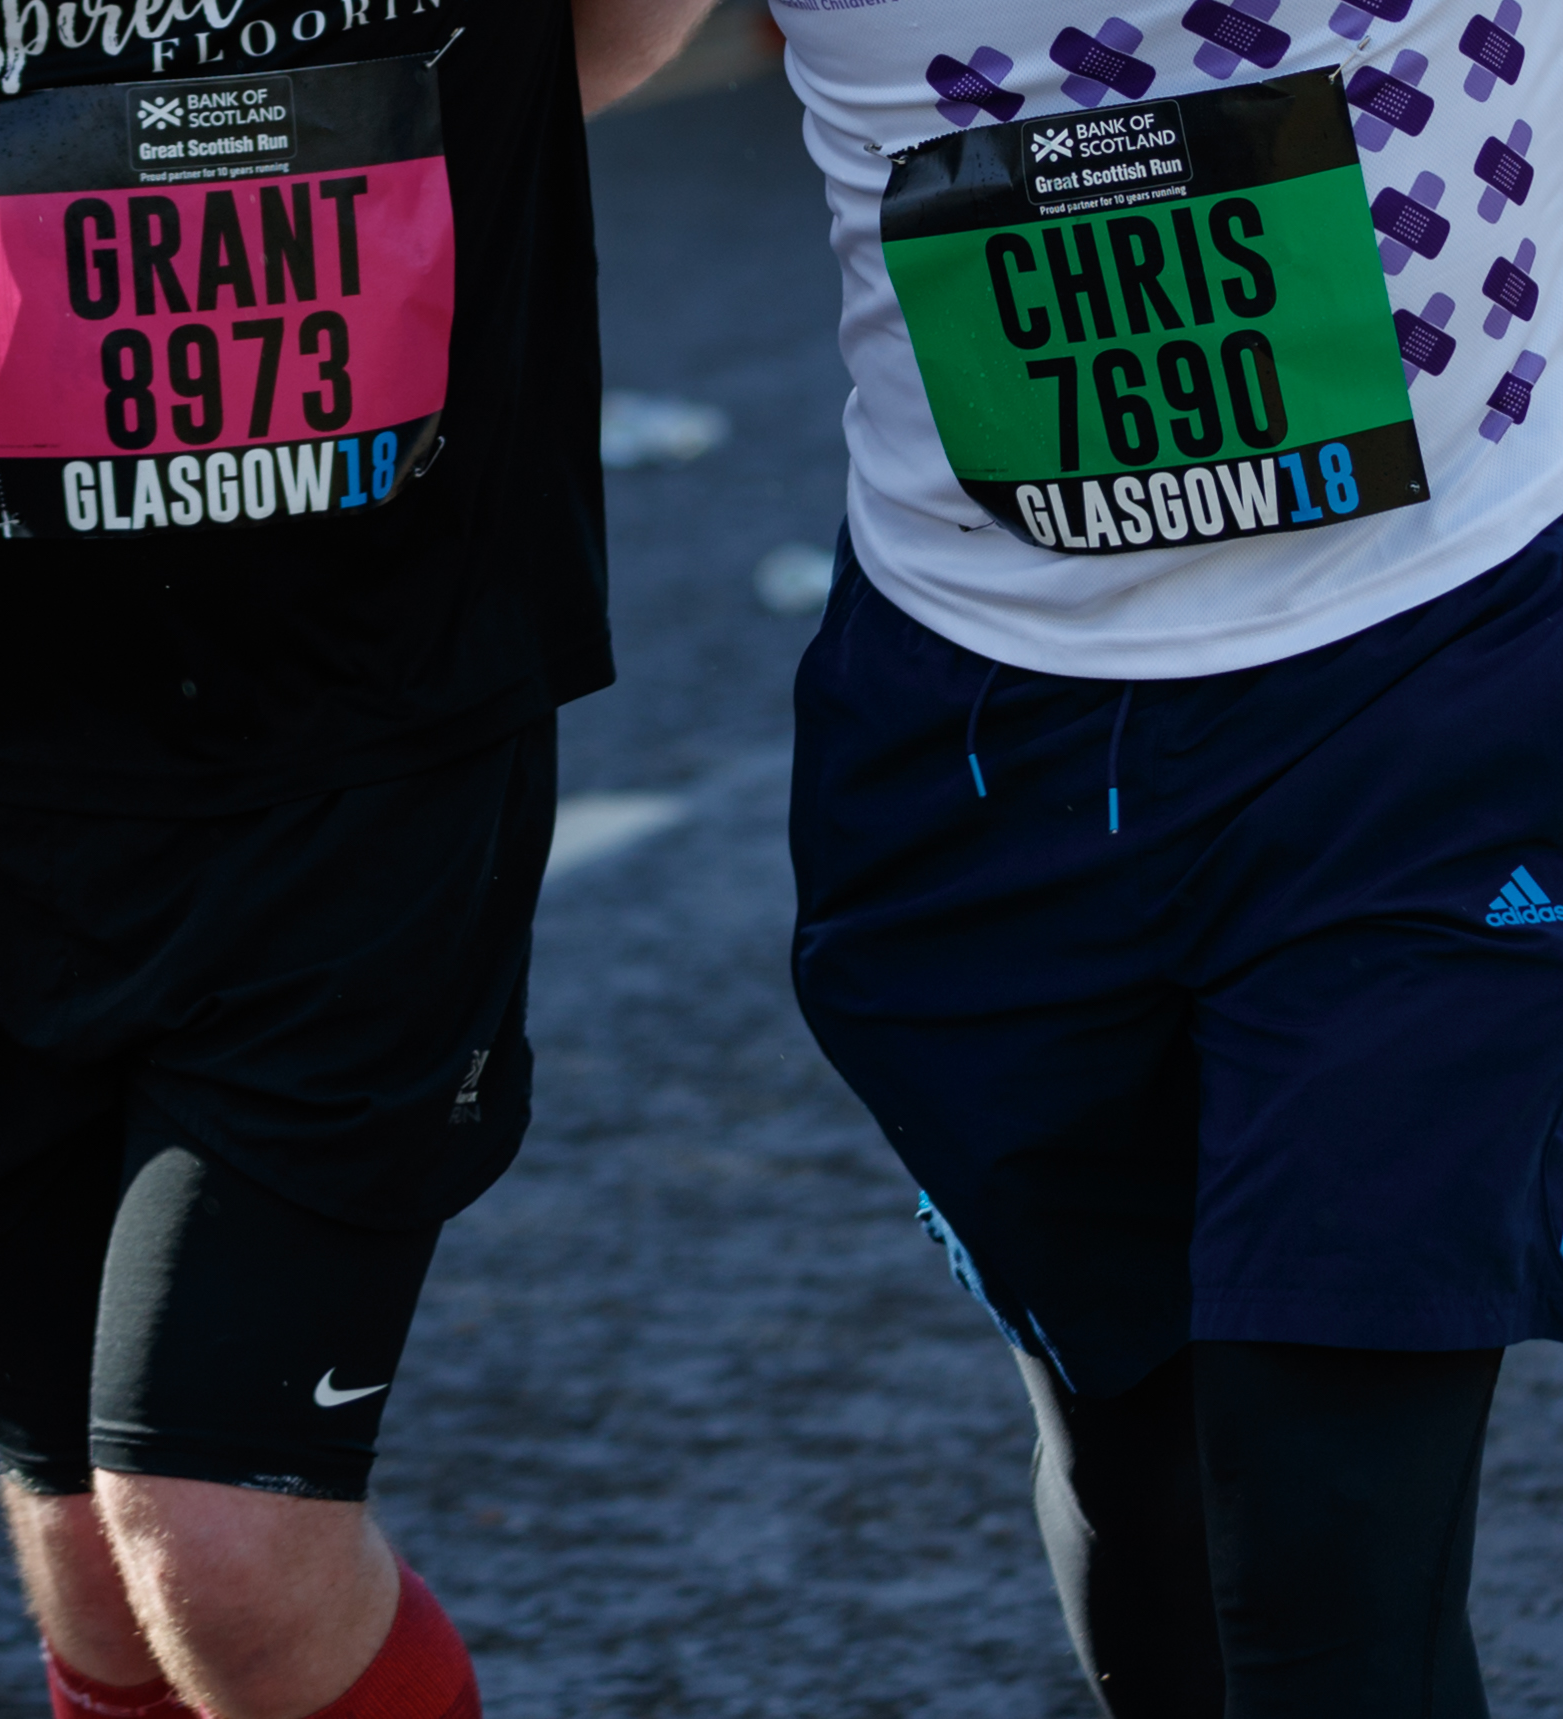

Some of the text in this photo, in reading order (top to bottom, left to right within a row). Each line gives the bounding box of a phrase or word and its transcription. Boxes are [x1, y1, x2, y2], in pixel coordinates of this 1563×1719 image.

[187, 88, 268, 110] BANK OF
[188, 105, 286, 128] SCOTLAND
[1076, 113, 1155, 139] BANK OF
[139, 134, 289, 160] Great Scottish Run
[1079, 129, 1176, 157] SCOTLAND
[140, 162, 290, 183] Proud partner for 10 years running
[1035, 158, 1183, 193] Great Scottish Run
[1039, 185, 1187, 216] Proud partner for 10 years running
[62, 175, 368, 321] GRANT
[985, 196, 1277, 351] CHRIS
[100, 310, 353, 451] 8973
[1025, 329, 1289, 472] 7690
